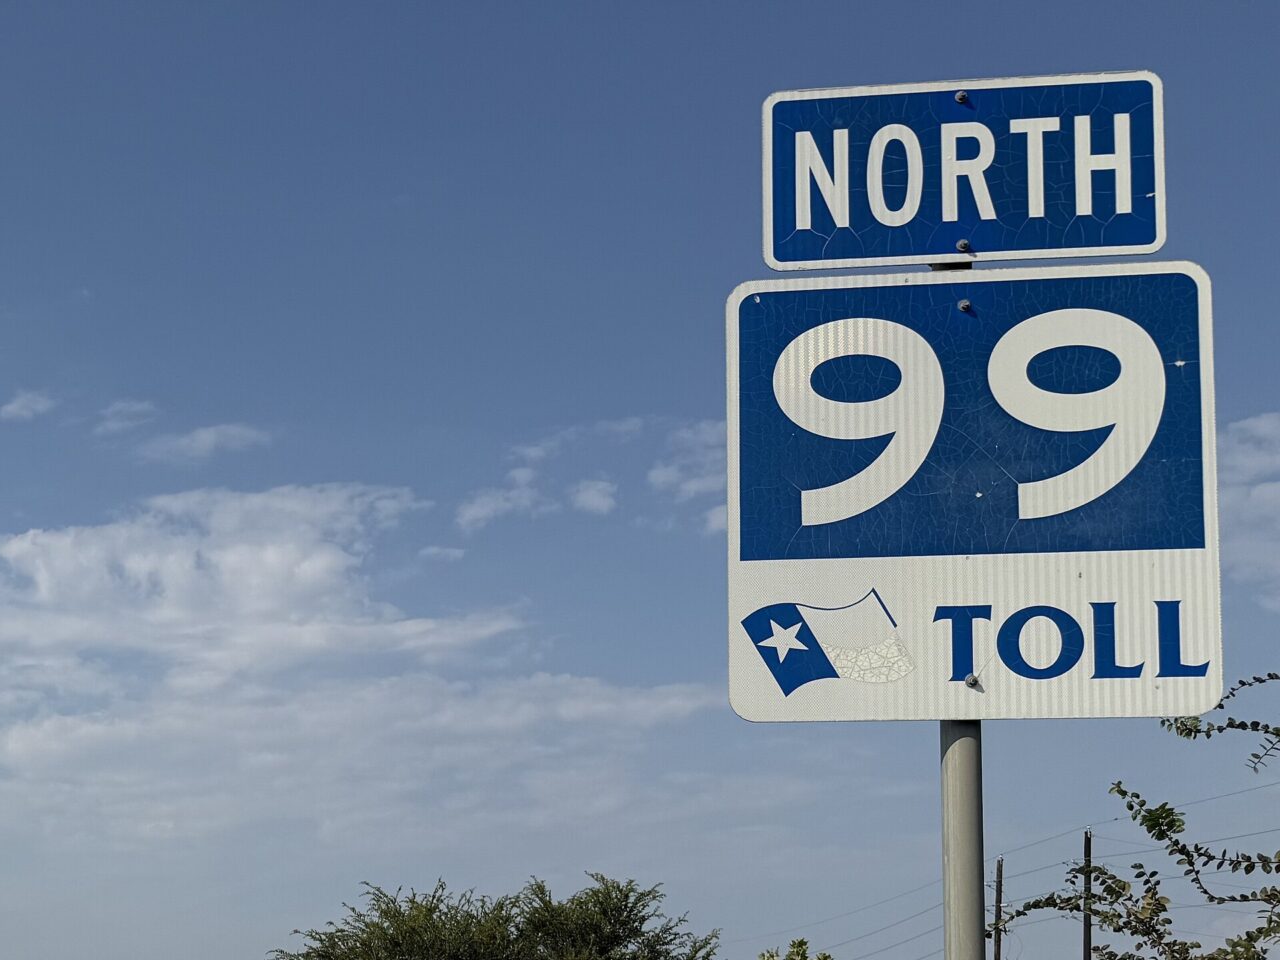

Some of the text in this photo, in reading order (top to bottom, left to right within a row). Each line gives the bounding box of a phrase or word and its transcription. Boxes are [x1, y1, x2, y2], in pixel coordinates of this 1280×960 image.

[794, 113, 1132, 231] NORTH
[772, 308, 1167, 527] 99
[933, 600, 1211, 682] TOLL
